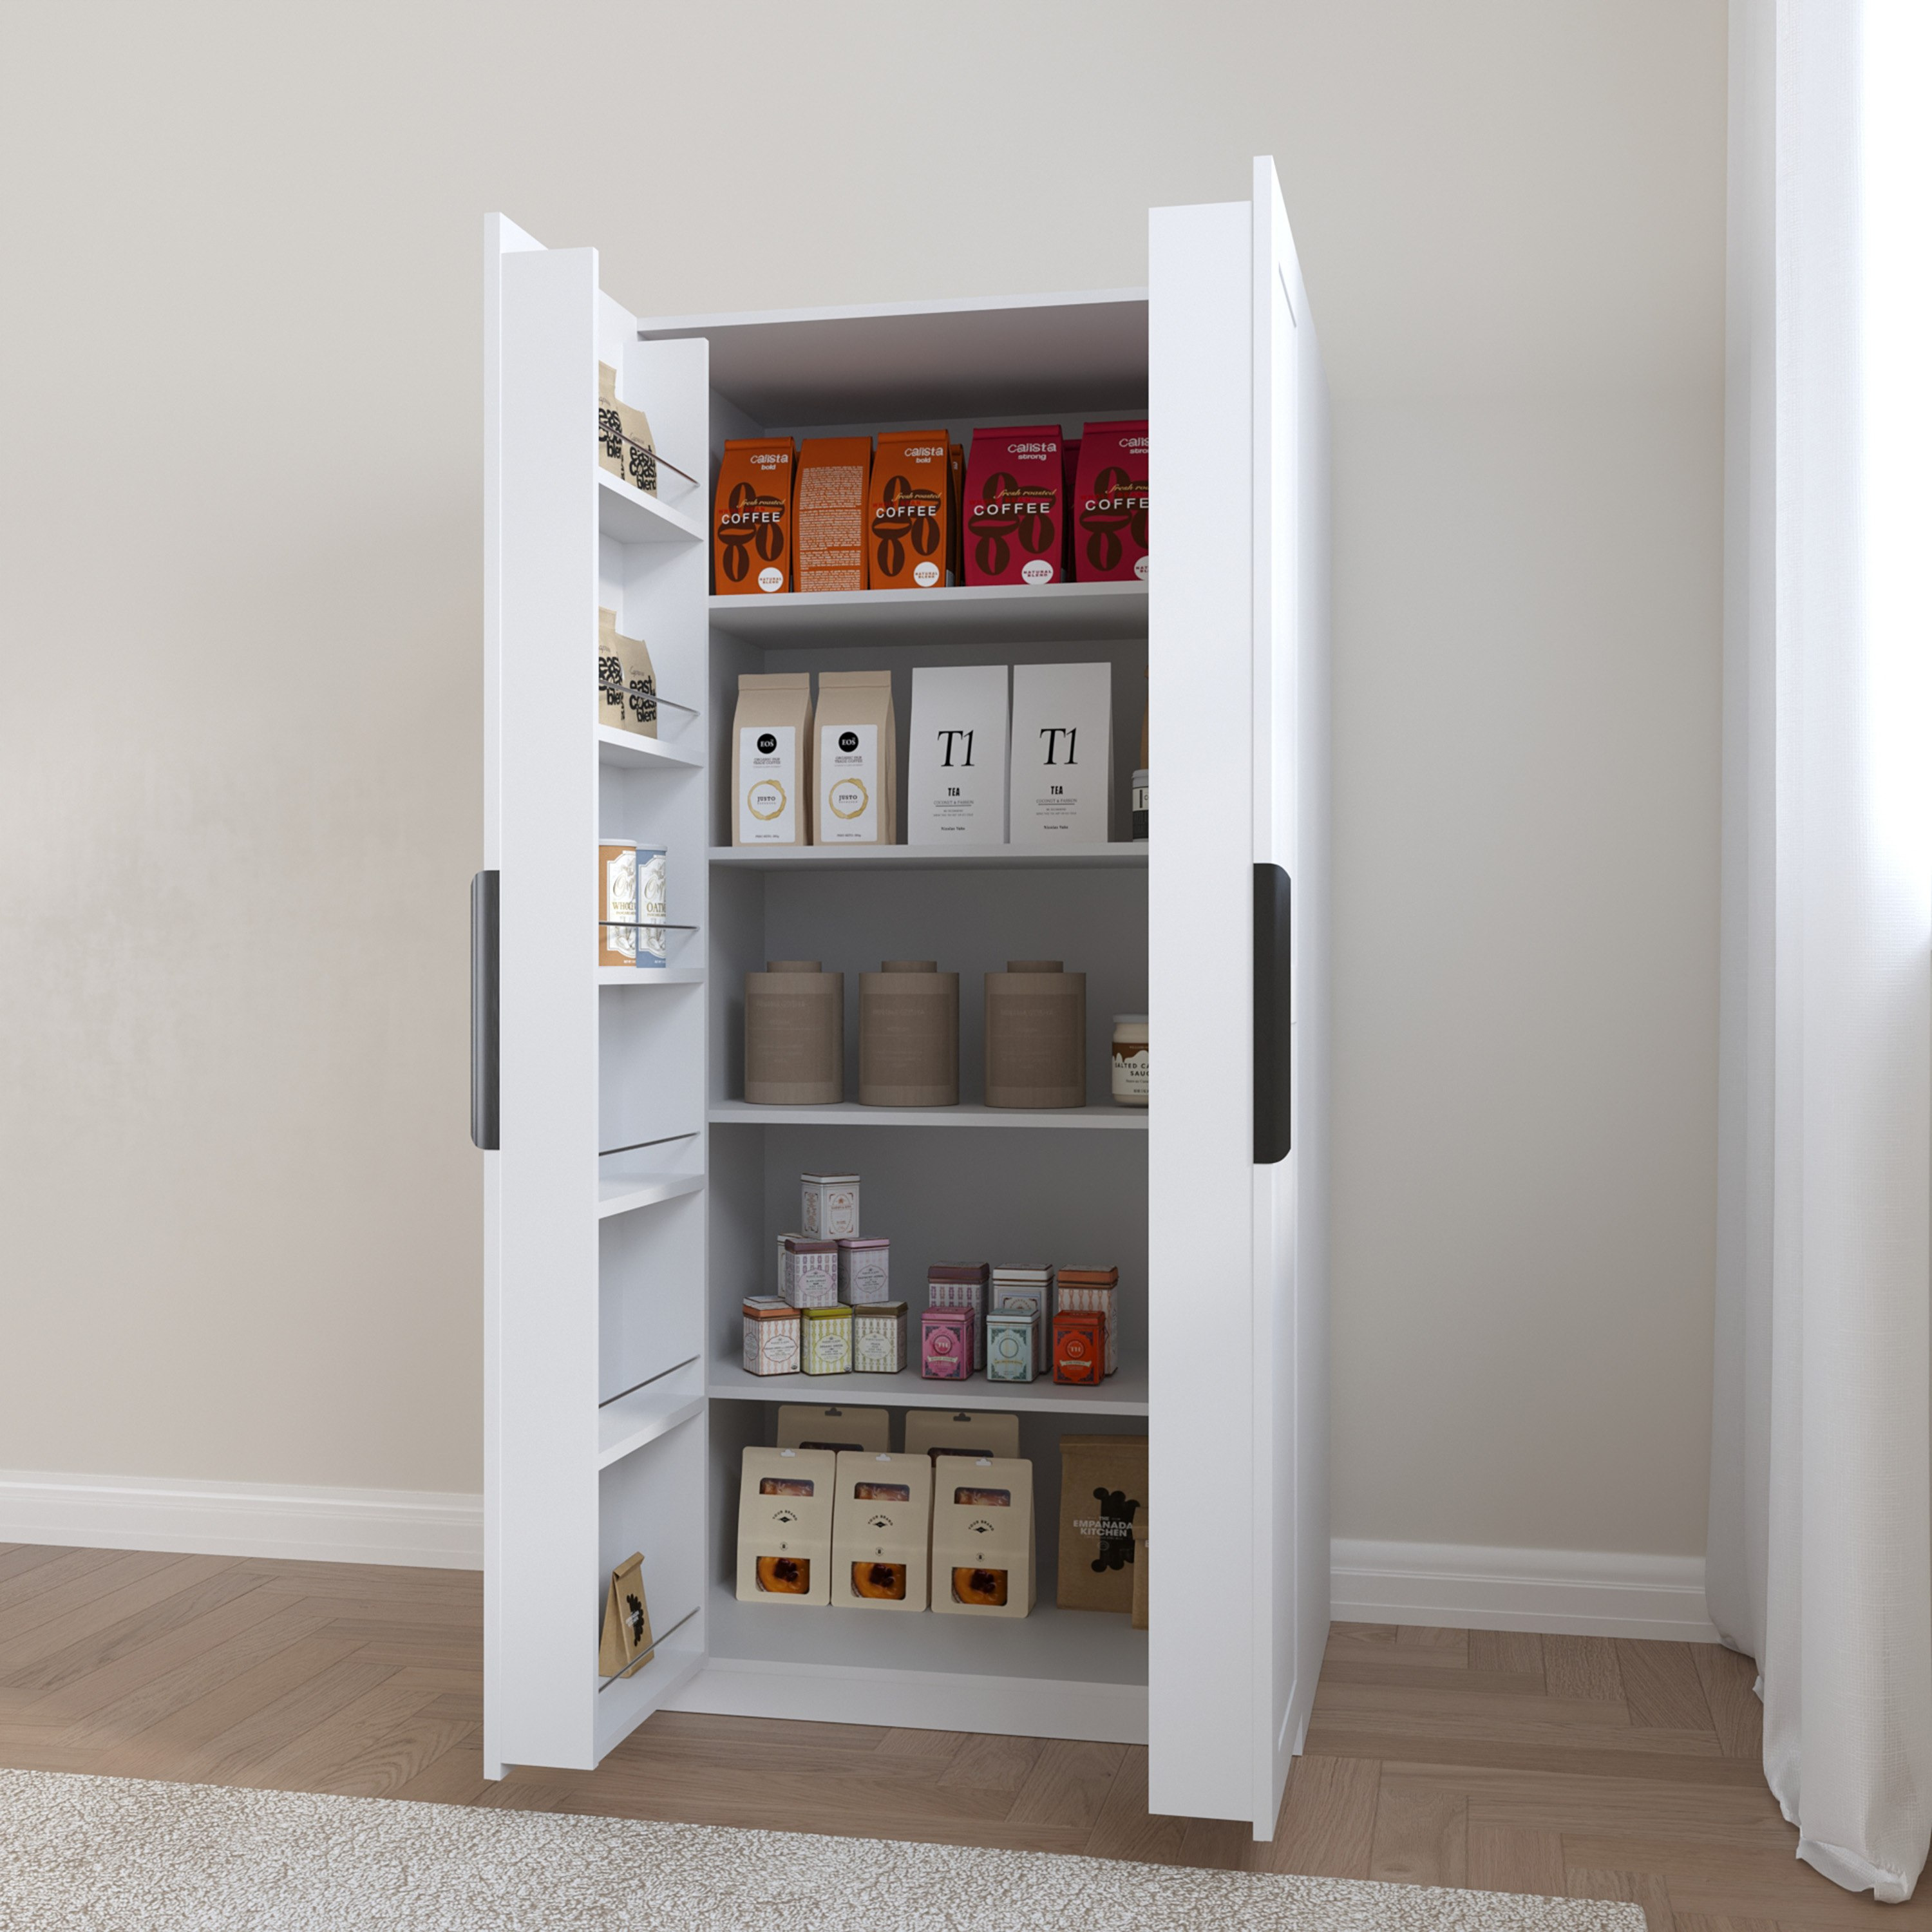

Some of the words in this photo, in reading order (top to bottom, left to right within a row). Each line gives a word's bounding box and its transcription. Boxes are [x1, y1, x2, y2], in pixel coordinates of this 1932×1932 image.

[993, 489, 1021, 499] fresh
[974, 503, 1050, 516] COFFEE
[1085, 498, 1149, 511] COFFE
[876, 506, 936, 518] COFFEE
[721, 513, 781, 524] COFFEE
[938, 730, 974, 766] T1
[1039, 727, 1078, 765] T1
[947, 787, 960, 797] TEA
[1050, 786, 1063, 795] TEA
[772, 1510, 783, 1519] YOUR
[784, 1510, 797, 1521] BRAND
[867, 1515, 878, 1524] YOUR
[880, 1515, 893, 1526] BRAND
[968, 1520, 979, 1530] YOUR
[981, 1520, 994, 1531] BRAND
[1073, 1520, 1133, 1530] EMPANADA
[1080, 1528, 1128, 1537] KITCHEN
